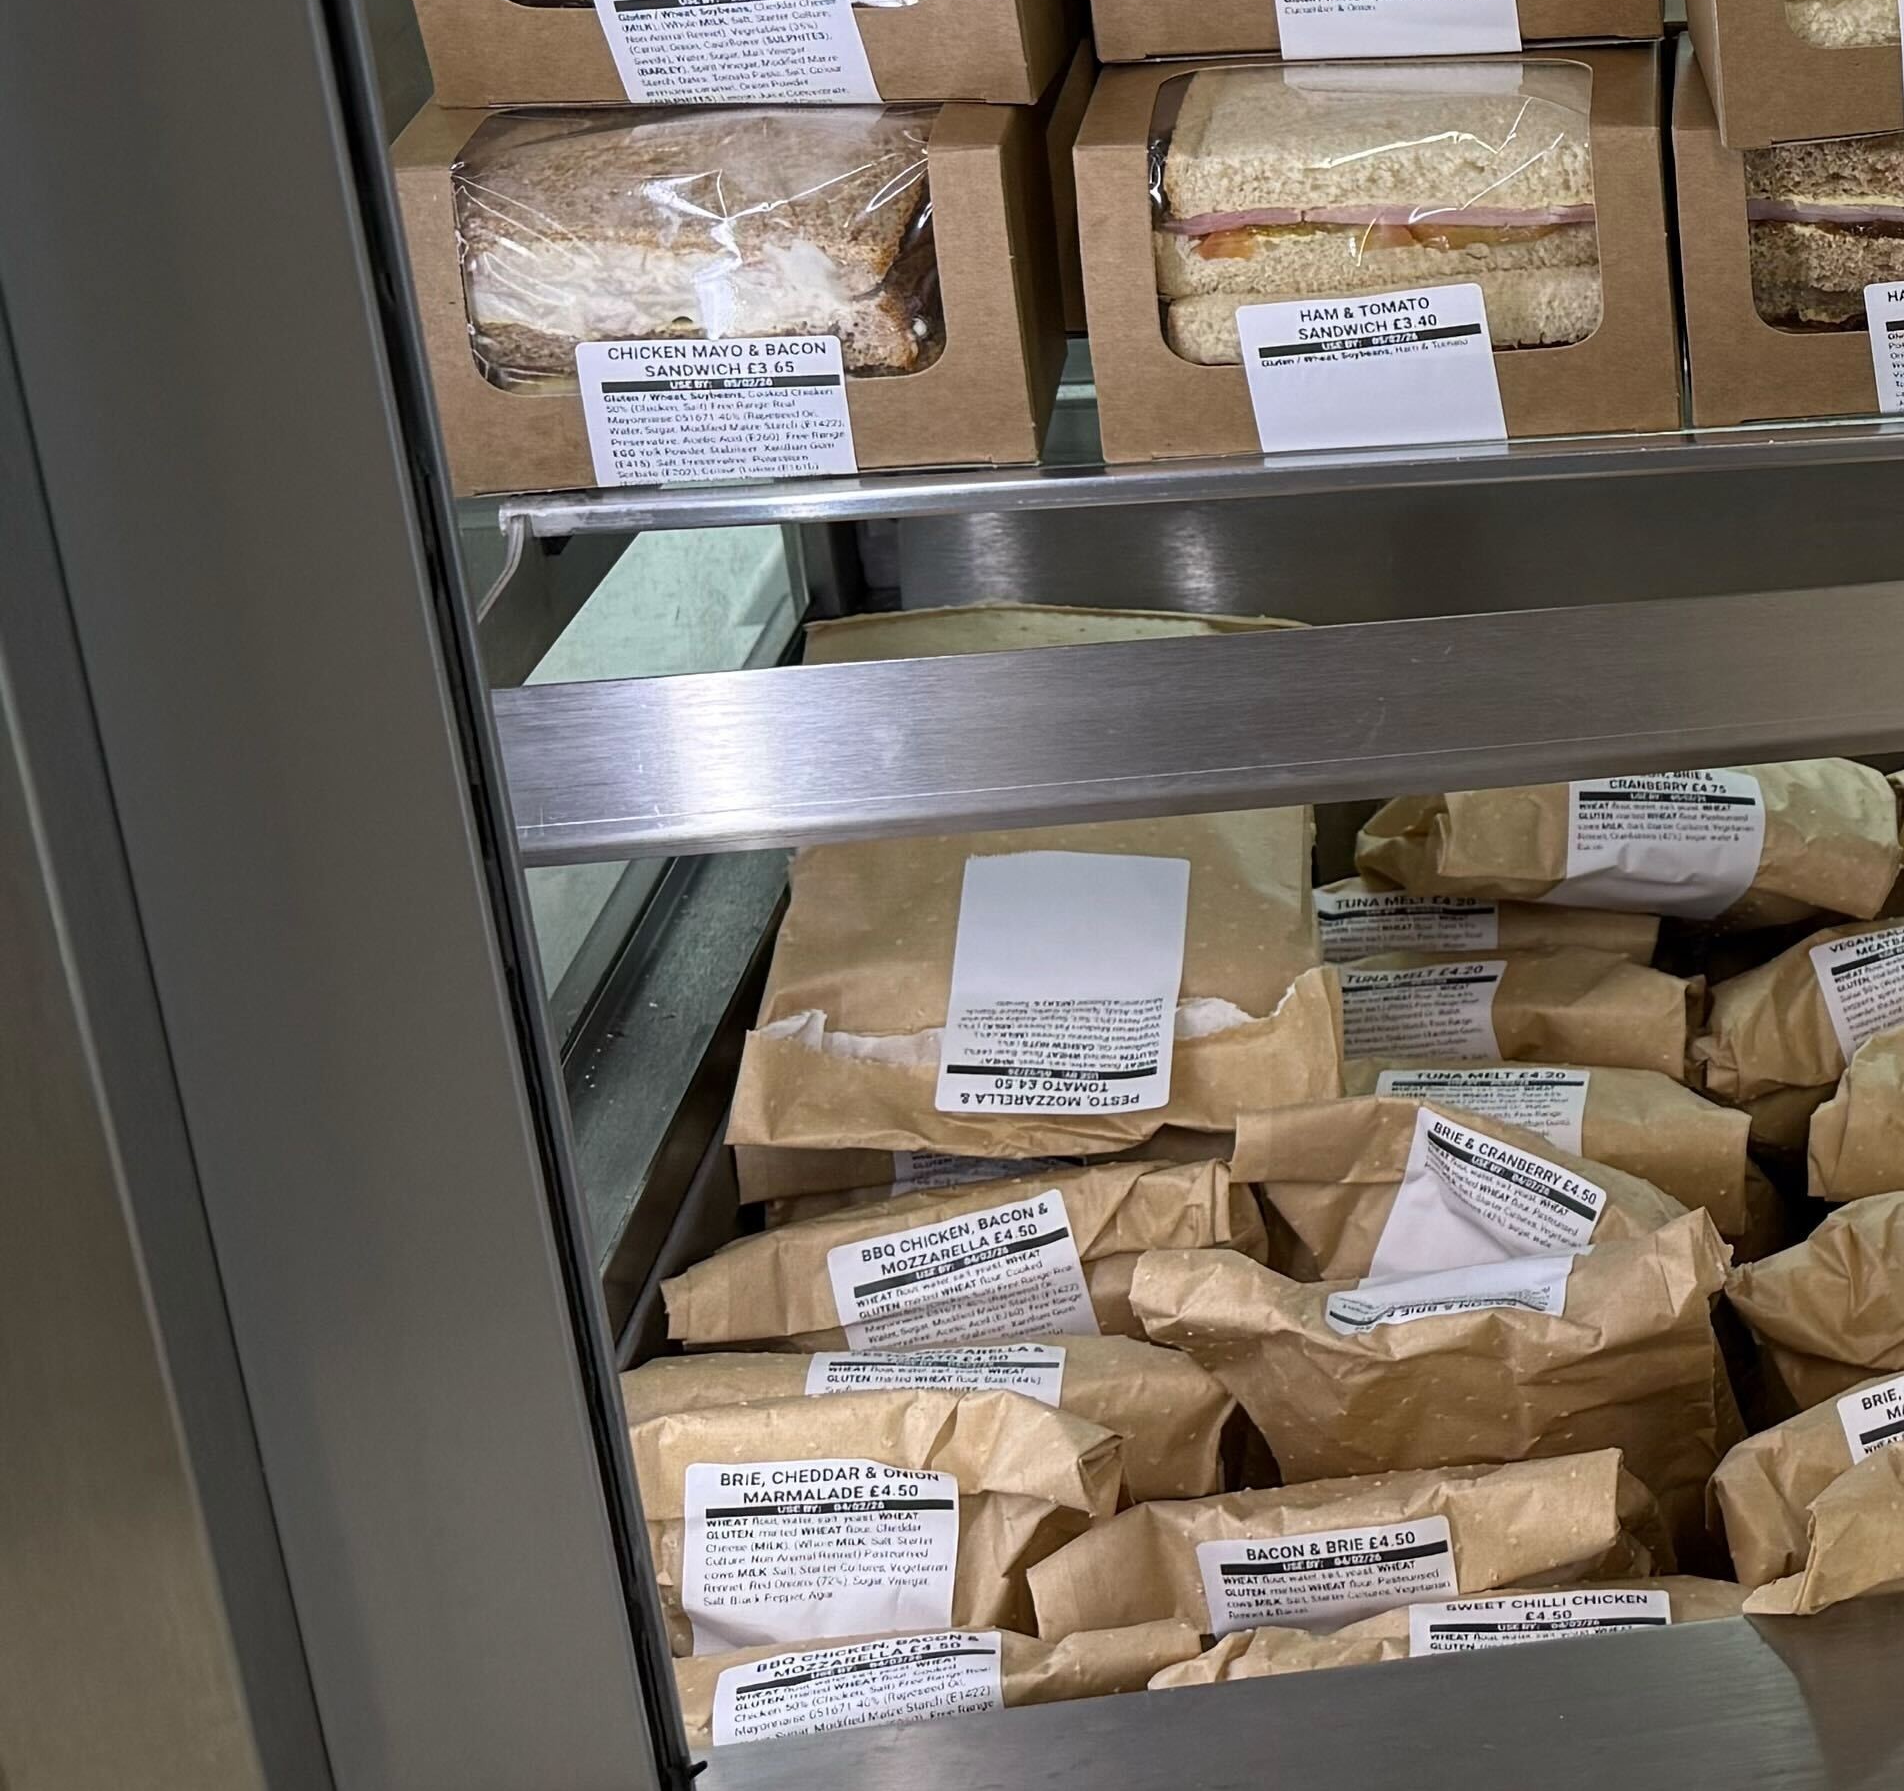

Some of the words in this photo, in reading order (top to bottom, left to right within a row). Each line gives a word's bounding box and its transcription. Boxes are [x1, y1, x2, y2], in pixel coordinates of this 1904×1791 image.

[1300, 308, 1339, 323] HAM
[1344, 306, 1354, 320] &
[1358, 297, 1430, 318] TOMATO
[1298, 320, 1388, 341] SANDWICH
[1393, 314, 1438, 331] £3.40
[608, 346, 686, 360] CHICKEN
[693, 345, 742, 358] MAYO
[749, 344, 759, 356] &
[766, 342, 826, 356] BACON
[645, 363, 741, 377] SANDWICH
[748, 362, 795, 375] £3.65
[1609, 780, 1688, 792] CRANBERRY
[1042, 1078, 1108, 1092] TOMATO
[976, 1093, 1081, 1107] MOZZARELLA
[1088, 1093, 1140, 1107] PESTO,
[1433, 1121, 1464, 1146] BRIE
[1465, 1138, 1474, 1150] &
[1479, 1143, 1563, 1187] CRANBERRY
[1562, 1179, 1598, 1205] £4.50
[861, 1244, 896, 1262] BBQ
[900, 1222, 975, 1254] CHICKEN,
[978, 1209, 1035, 1231] BACON
[1038, 1203, 1048, 1215] &
[882, 1236, 990, 1276] MOZZARELLA
[994, 1224, 1038, 1244] £4.50
[720, 1471, 766, 1487] BRIE,
[772, 1467, 860, 1485] CHEDDAR
[866, 1467, 877, 1480] &
[883, 1468, 939, 1482] ONION
[743, 1486, 864, 1504] MARMALADE
[870, 1484, 919, 1498] £4.50
[1246, 1544, 1306, 1561] BACON
[1310, 1542, 1322, 1556] &
[1327, 1538, 1364, 1555] BRIE
[1369, 1531, 1416, 1550] £4.50
[1447, 1600, 1506, 1612] SWEET
[1511, 1596, 1568, 1609] CHILLI
[1572, 1593, 1648, 1606] CHICKEN
[1526, 1610, 1571, 1621] £4.50
[757, 1657, 795, 1673] BBQ
[801, 1642, 890, 1663] CHICKEN,
